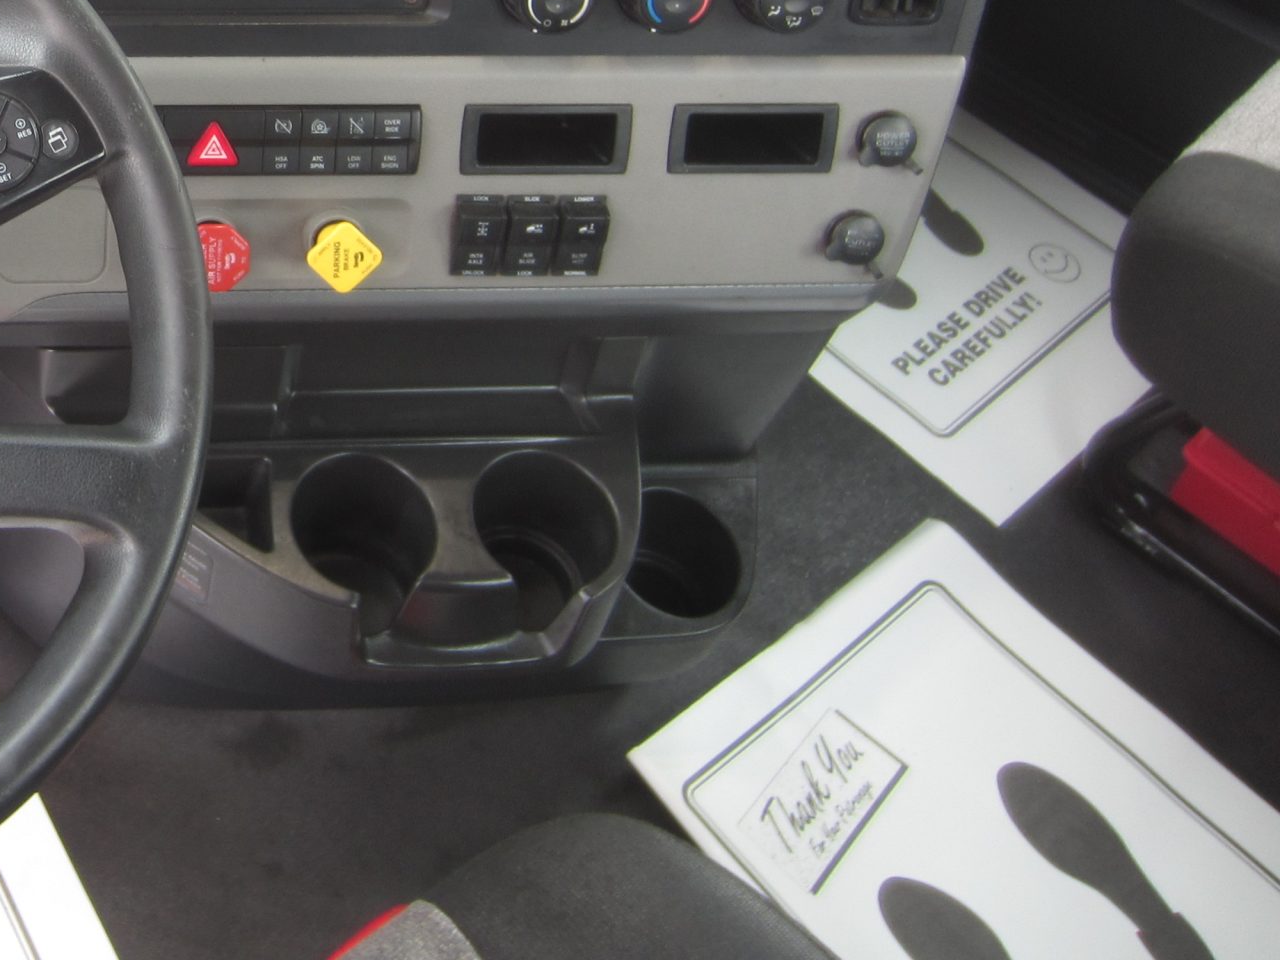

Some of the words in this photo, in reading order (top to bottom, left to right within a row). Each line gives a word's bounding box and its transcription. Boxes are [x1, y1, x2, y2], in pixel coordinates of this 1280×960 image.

[17, 128, 32, 139] RES
[208, 237, 217, 270] SUPPLY
[333, 241, 341, 278] PARKING
[207, 271, 216, 284] AIR
[891, 311, 971, 376] PLEASE
[962, 266, 1026, 319] DRIVE
[927, 291, 1043, 387] CAREFULLY!
[760, 760, 831, 853] Thank
[814, 734, 864, 784] You
